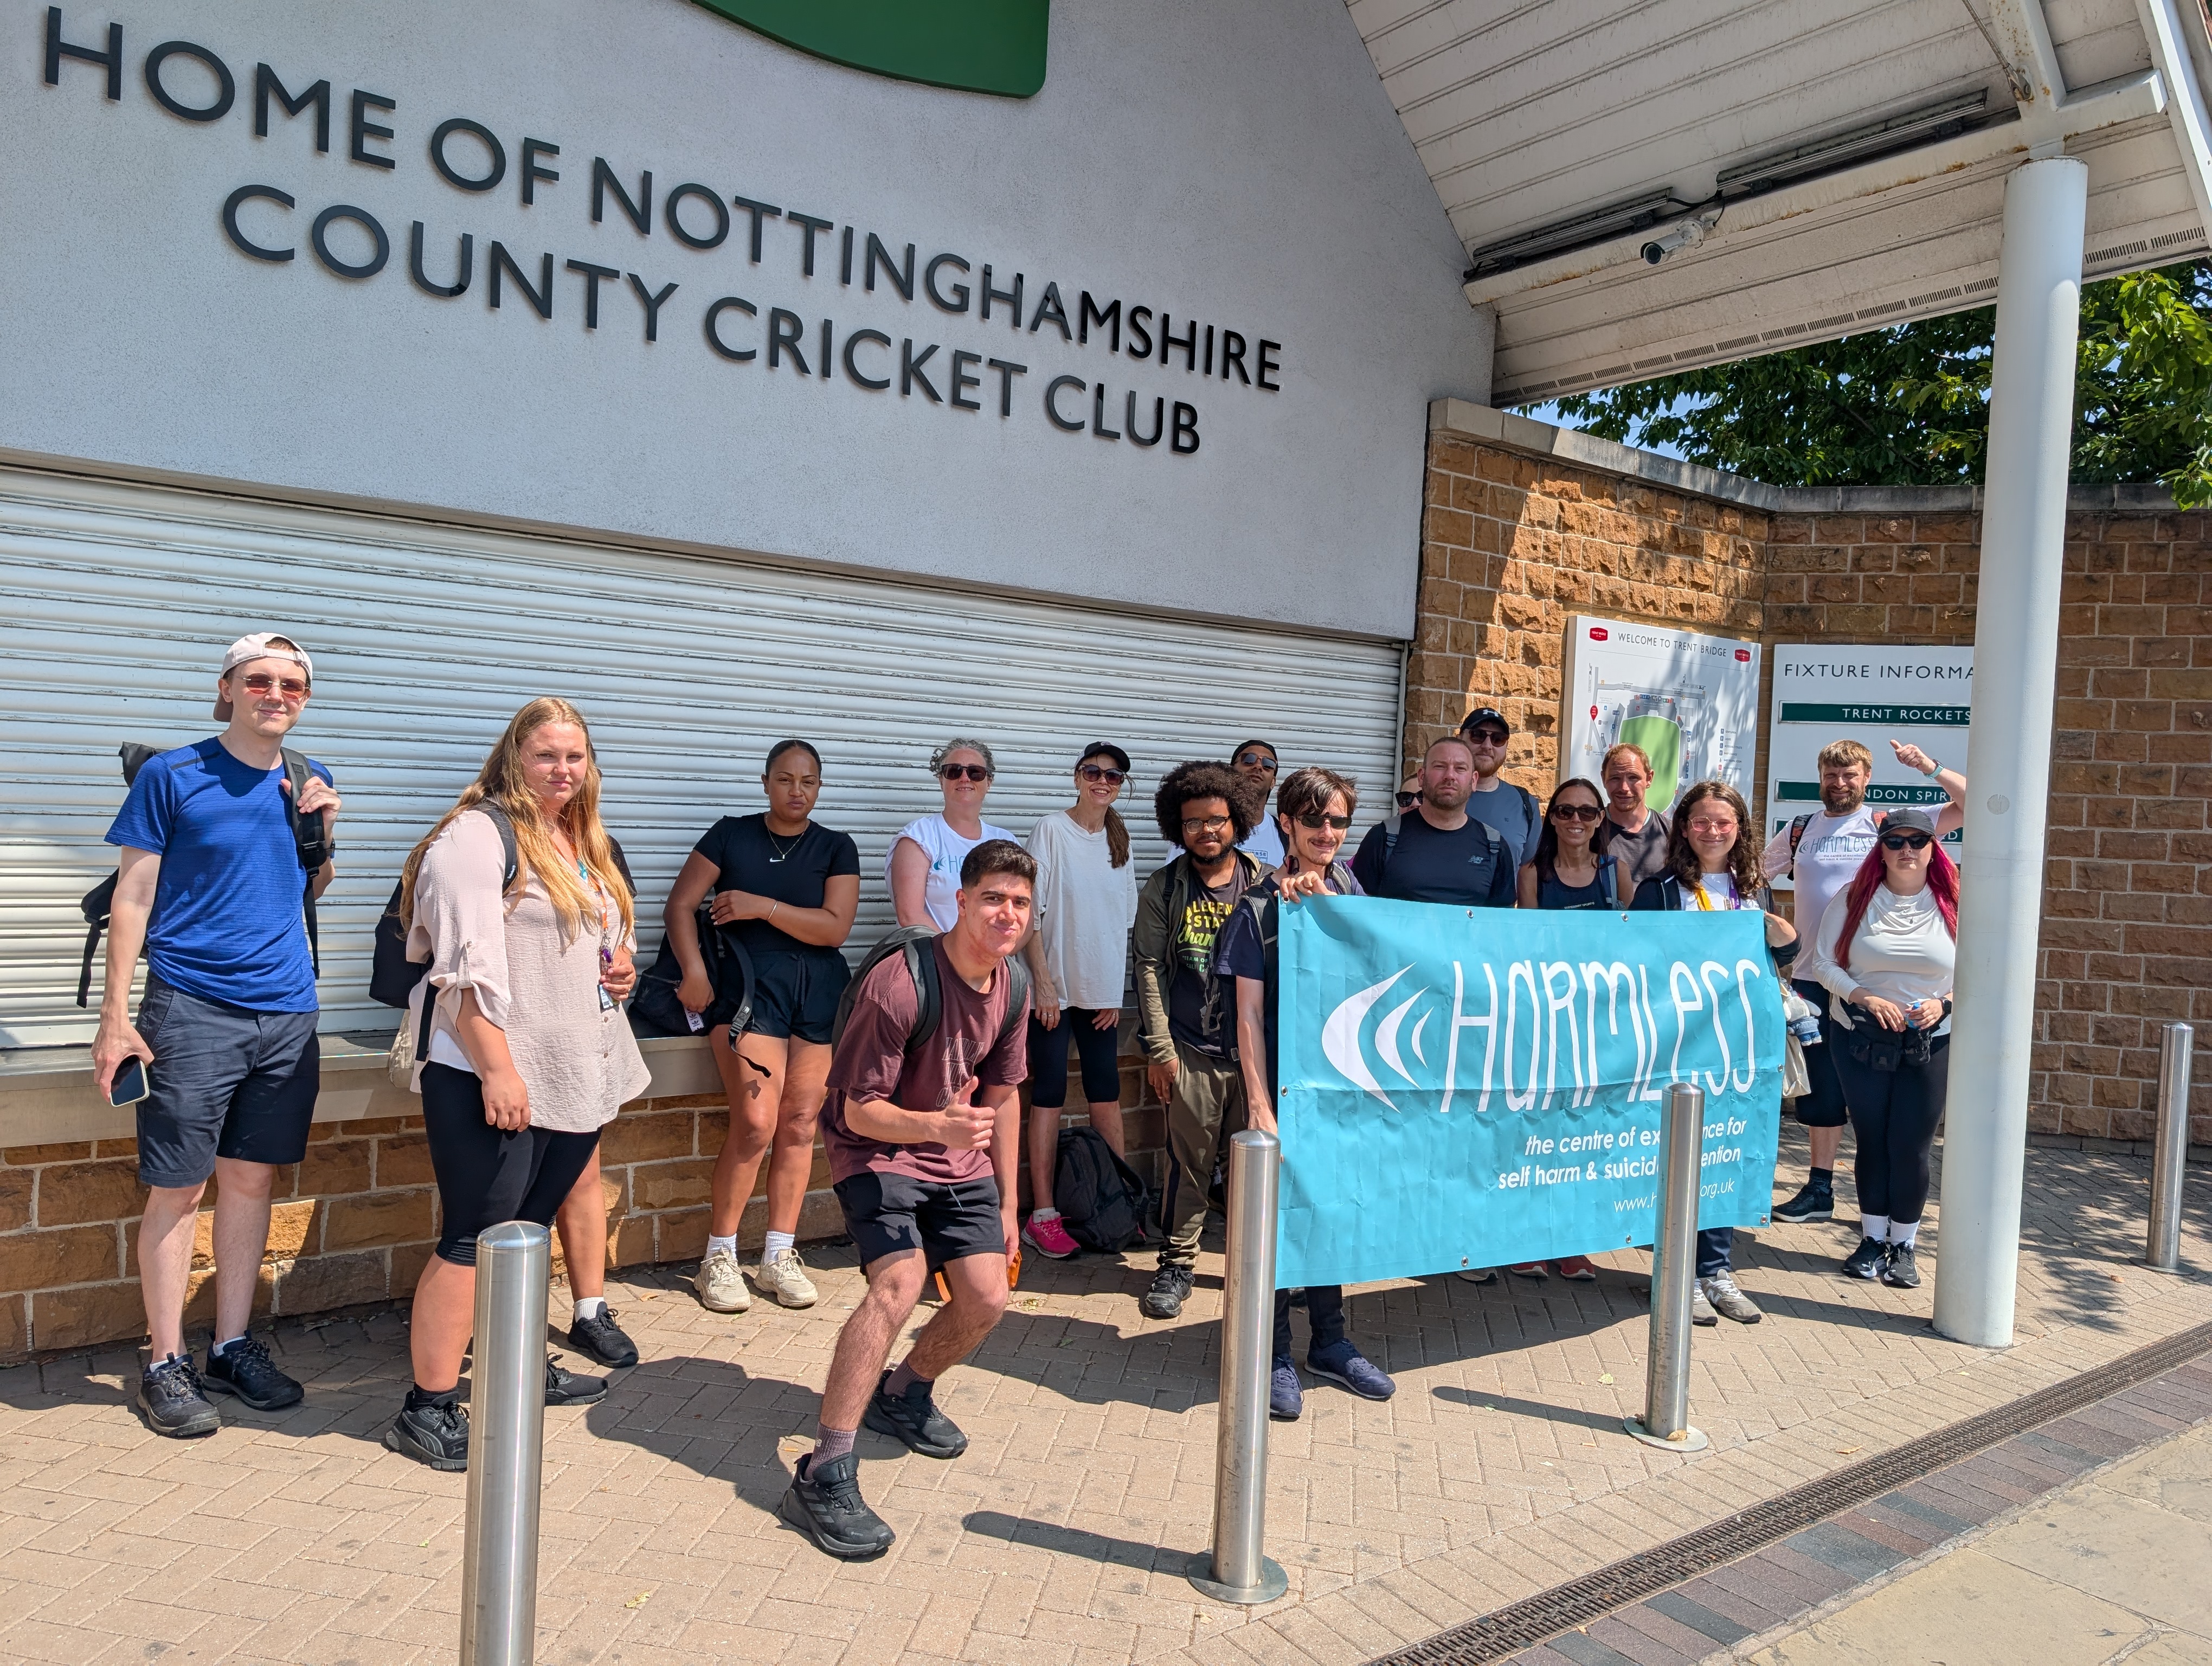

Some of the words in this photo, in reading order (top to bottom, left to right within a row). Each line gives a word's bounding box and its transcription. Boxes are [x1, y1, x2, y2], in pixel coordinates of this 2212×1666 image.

[45, 5, 396, 170] HOME
[431, 118, 560, 205] OF
[593, 156, 1281, 392] NOTTINGHAMSHIRE
[223, 184, 680, 342] COUNTY
[705, 296, 1027, 416] CRICKET
[1046, 375, 1201, 454] CLUB
[1618, 632, 1657, 646] WELCOME
[1660, 638, 1670, 649] TO
[1674, 640, 1698, 652] TRENT
[1700, 645, 1727, 657] BRIDGE
[1784, 664, 1870, 678] FIXTURE
[1880, 665, 1973, 679] INFORMA
[1842, 708, 1893, 719] TRENT
[1900, 709, 1971, 721] ROCKETS
[1865, 789, 1909, 800] NDON
[1916, 791, 1952, 802] SPIR
[1192, 900, 1237, 915] LEGEN
[1193, 915, 1225, 929] STA
[1525, 1135, 1554, 1156] the
[1559, 1130, 1614, 1154] centre
[1619, 1126, 1636, 1147] of
[1640, 1123, 1724, 1146] exnce
[1727, 1116, 1747, 1136] for
[1498, 1164, 1531, 1190] self
[1535, 1165, 1580, 1186] harm
[1586, 1163, 1598, 1181] &
[1604, 1155, 1659, 1180] suicid
[1701, 1146, 1741, 1168] ention
